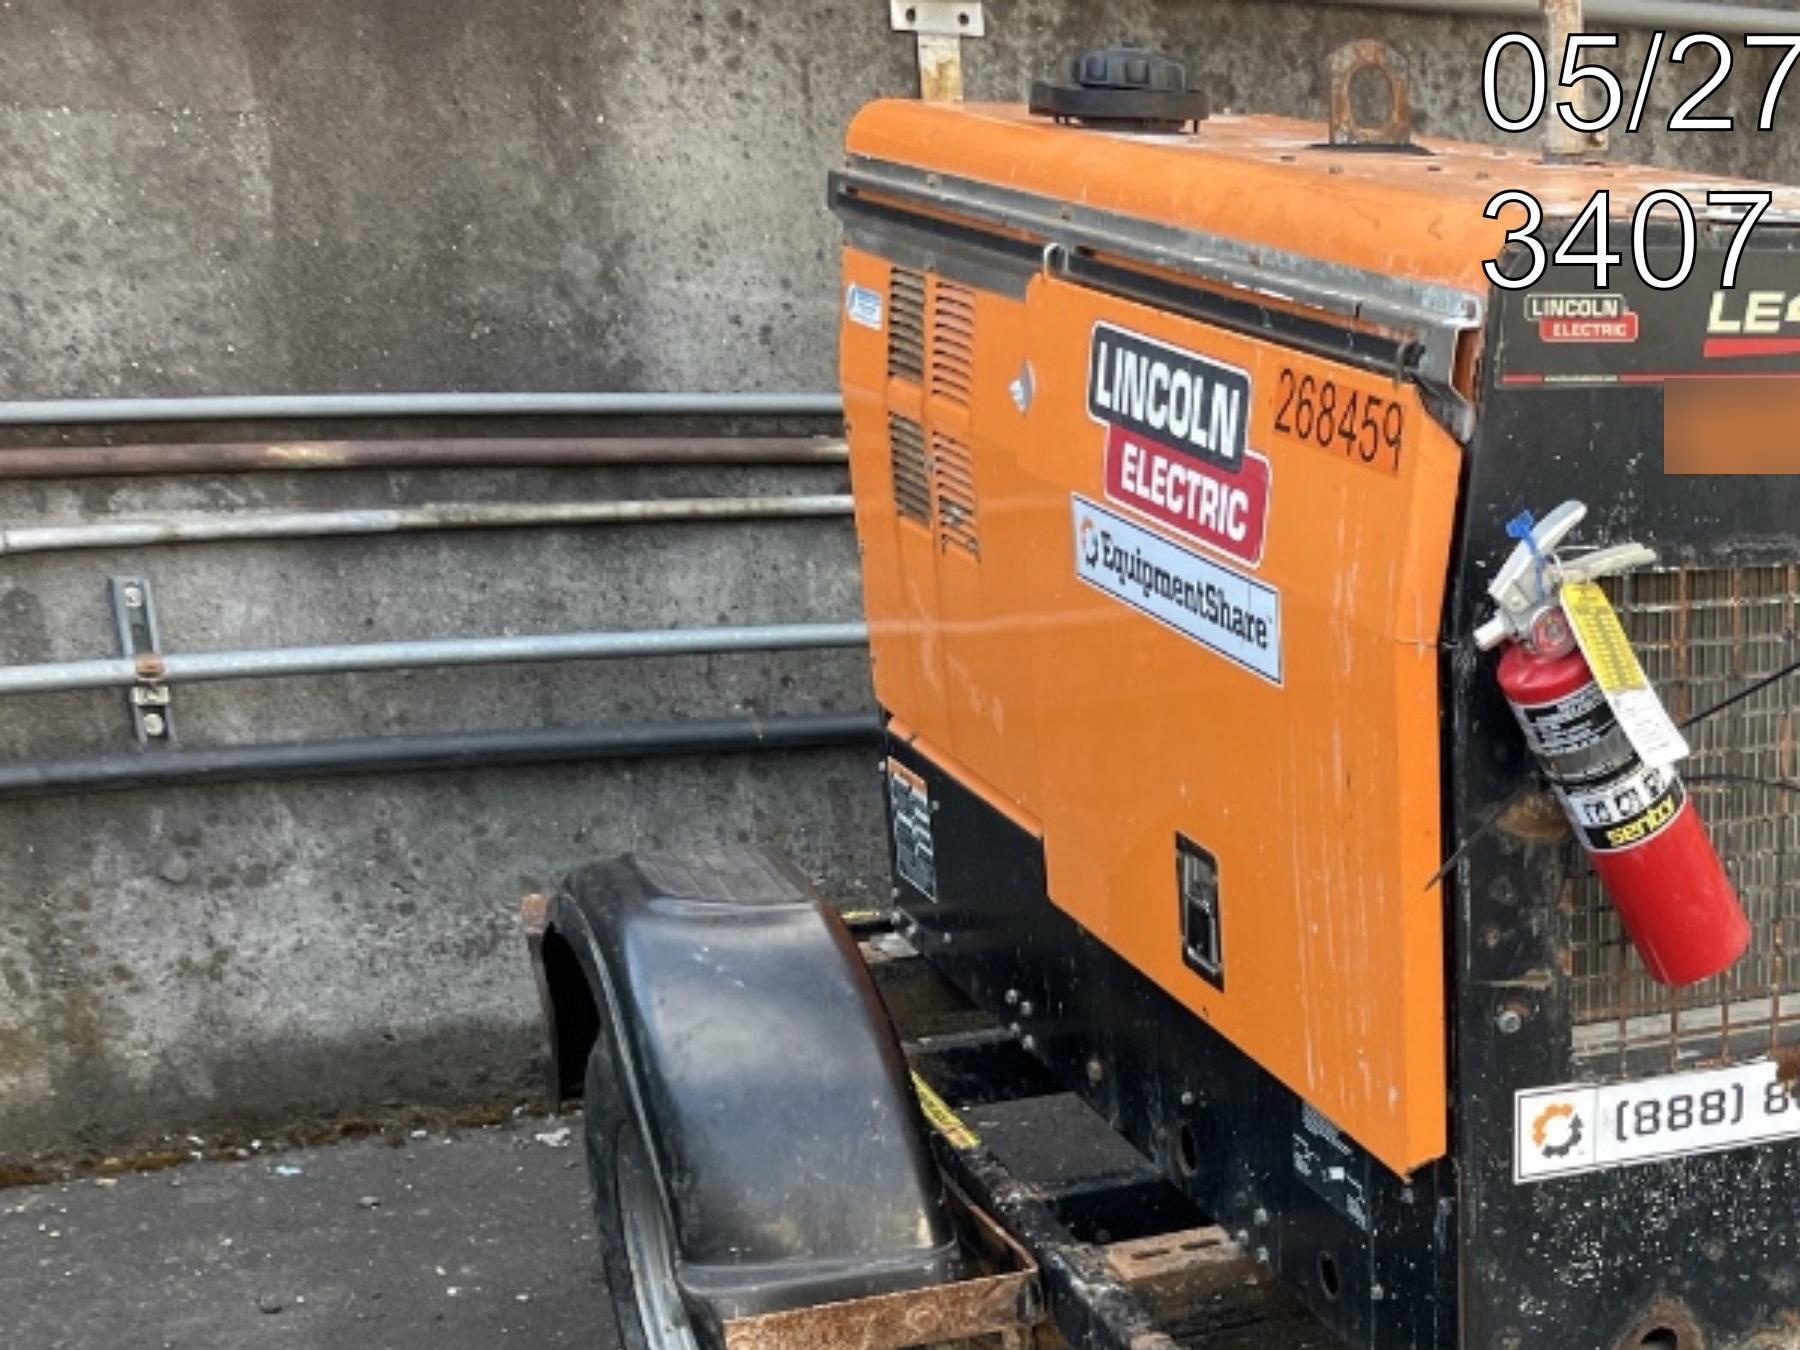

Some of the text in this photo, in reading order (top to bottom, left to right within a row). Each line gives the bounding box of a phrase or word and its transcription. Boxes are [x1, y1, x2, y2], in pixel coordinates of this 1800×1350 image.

[1531, 298, 1618, 318] LINCOLN
[1553, 322, 1628, 338] ELECTRIC
[1093, 340, 1241, 458] LINCOLN
[1273, 367, 1404, 473] 268459
[1120, 443, 1251, 544] ELECTRIC
[1100, 530, 1269, 650] EquipmentShare
[1615, 1083, 1743, 1142] (888)
